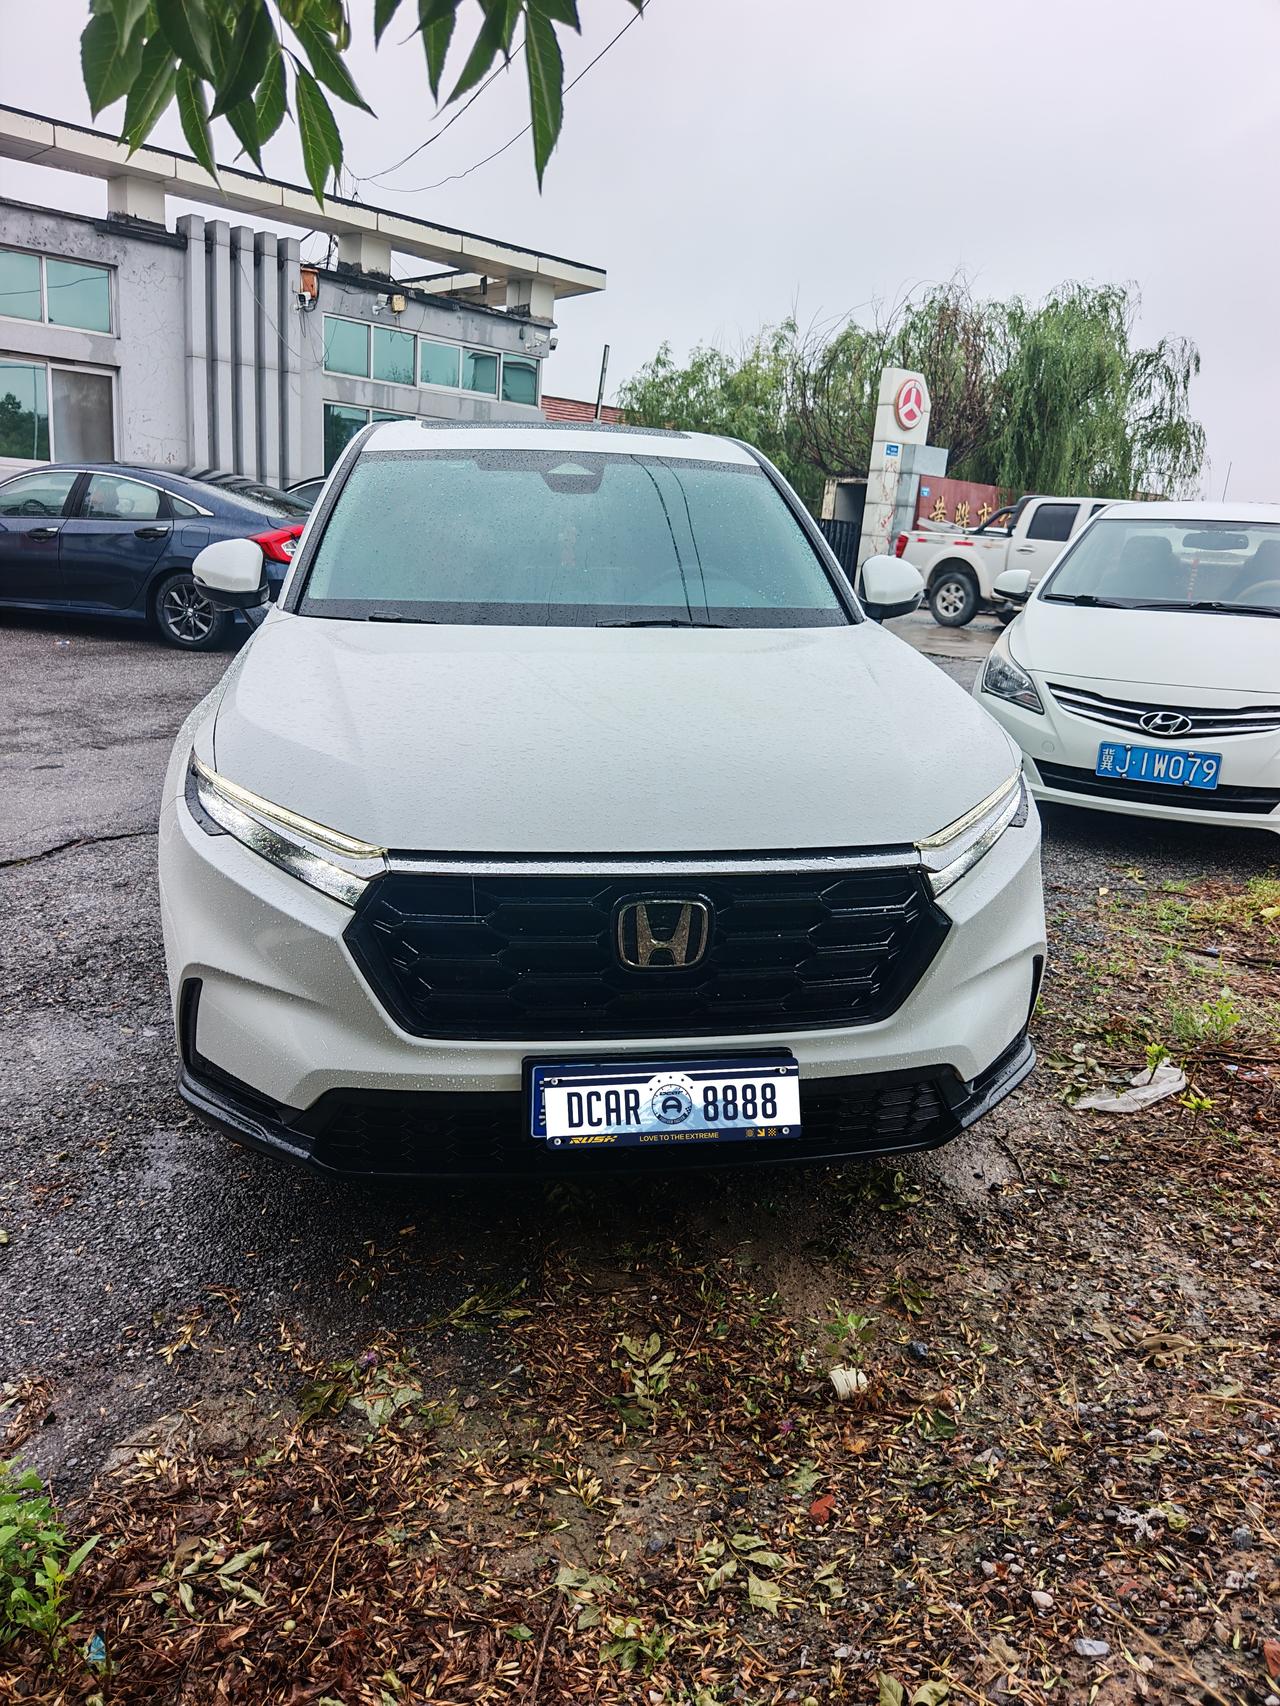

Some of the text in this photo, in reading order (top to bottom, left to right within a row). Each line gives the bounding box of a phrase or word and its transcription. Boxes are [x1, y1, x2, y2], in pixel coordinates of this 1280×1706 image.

[566, 1089, 641, 1128] DCAR
[703, 1083, 777, 1121] 8888
[568, 1135, 618, 1144] RUSH
